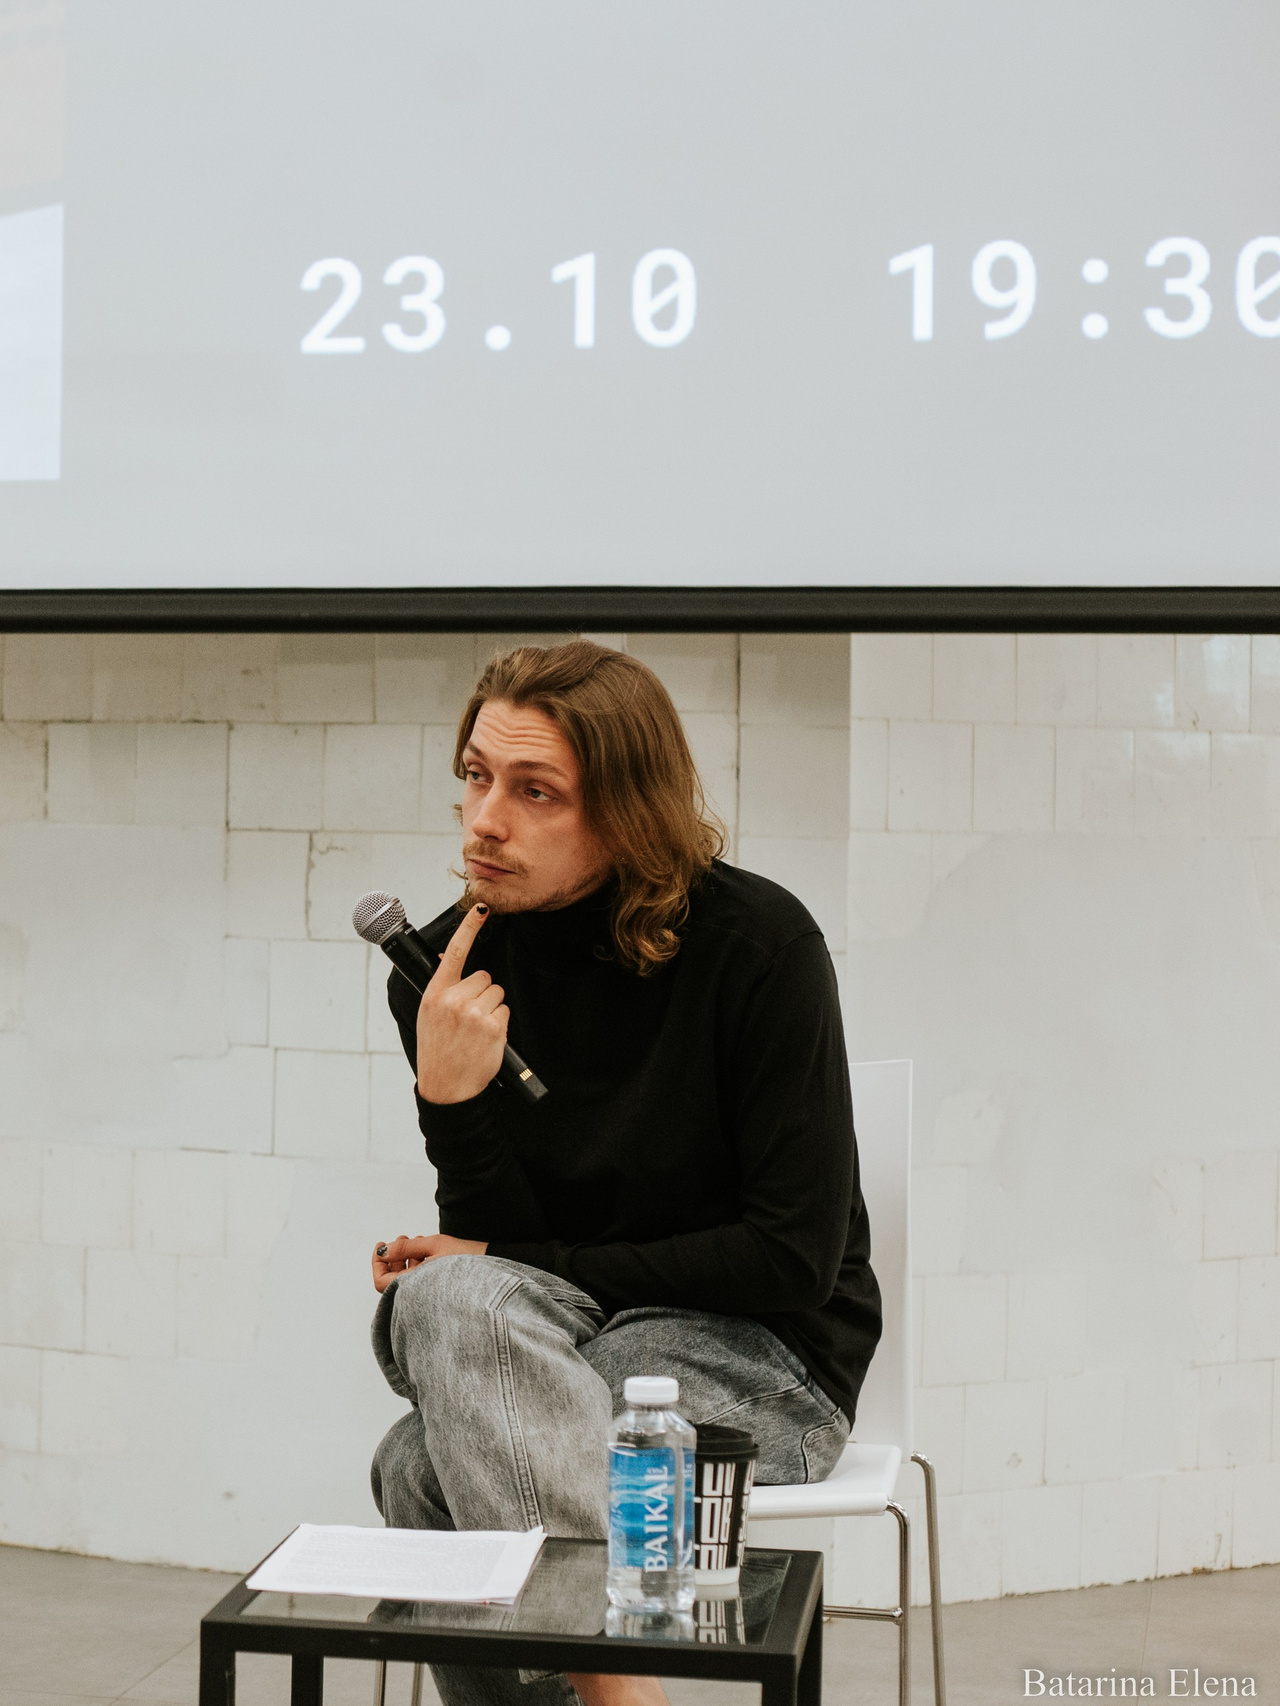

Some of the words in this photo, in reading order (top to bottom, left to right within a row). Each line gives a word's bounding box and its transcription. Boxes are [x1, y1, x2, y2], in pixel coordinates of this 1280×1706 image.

[300, 248, 697, 354] 23.10
[888, 236, 1280, 341] 19:30
[644, 1465, 668, 1573] BAIKAL
